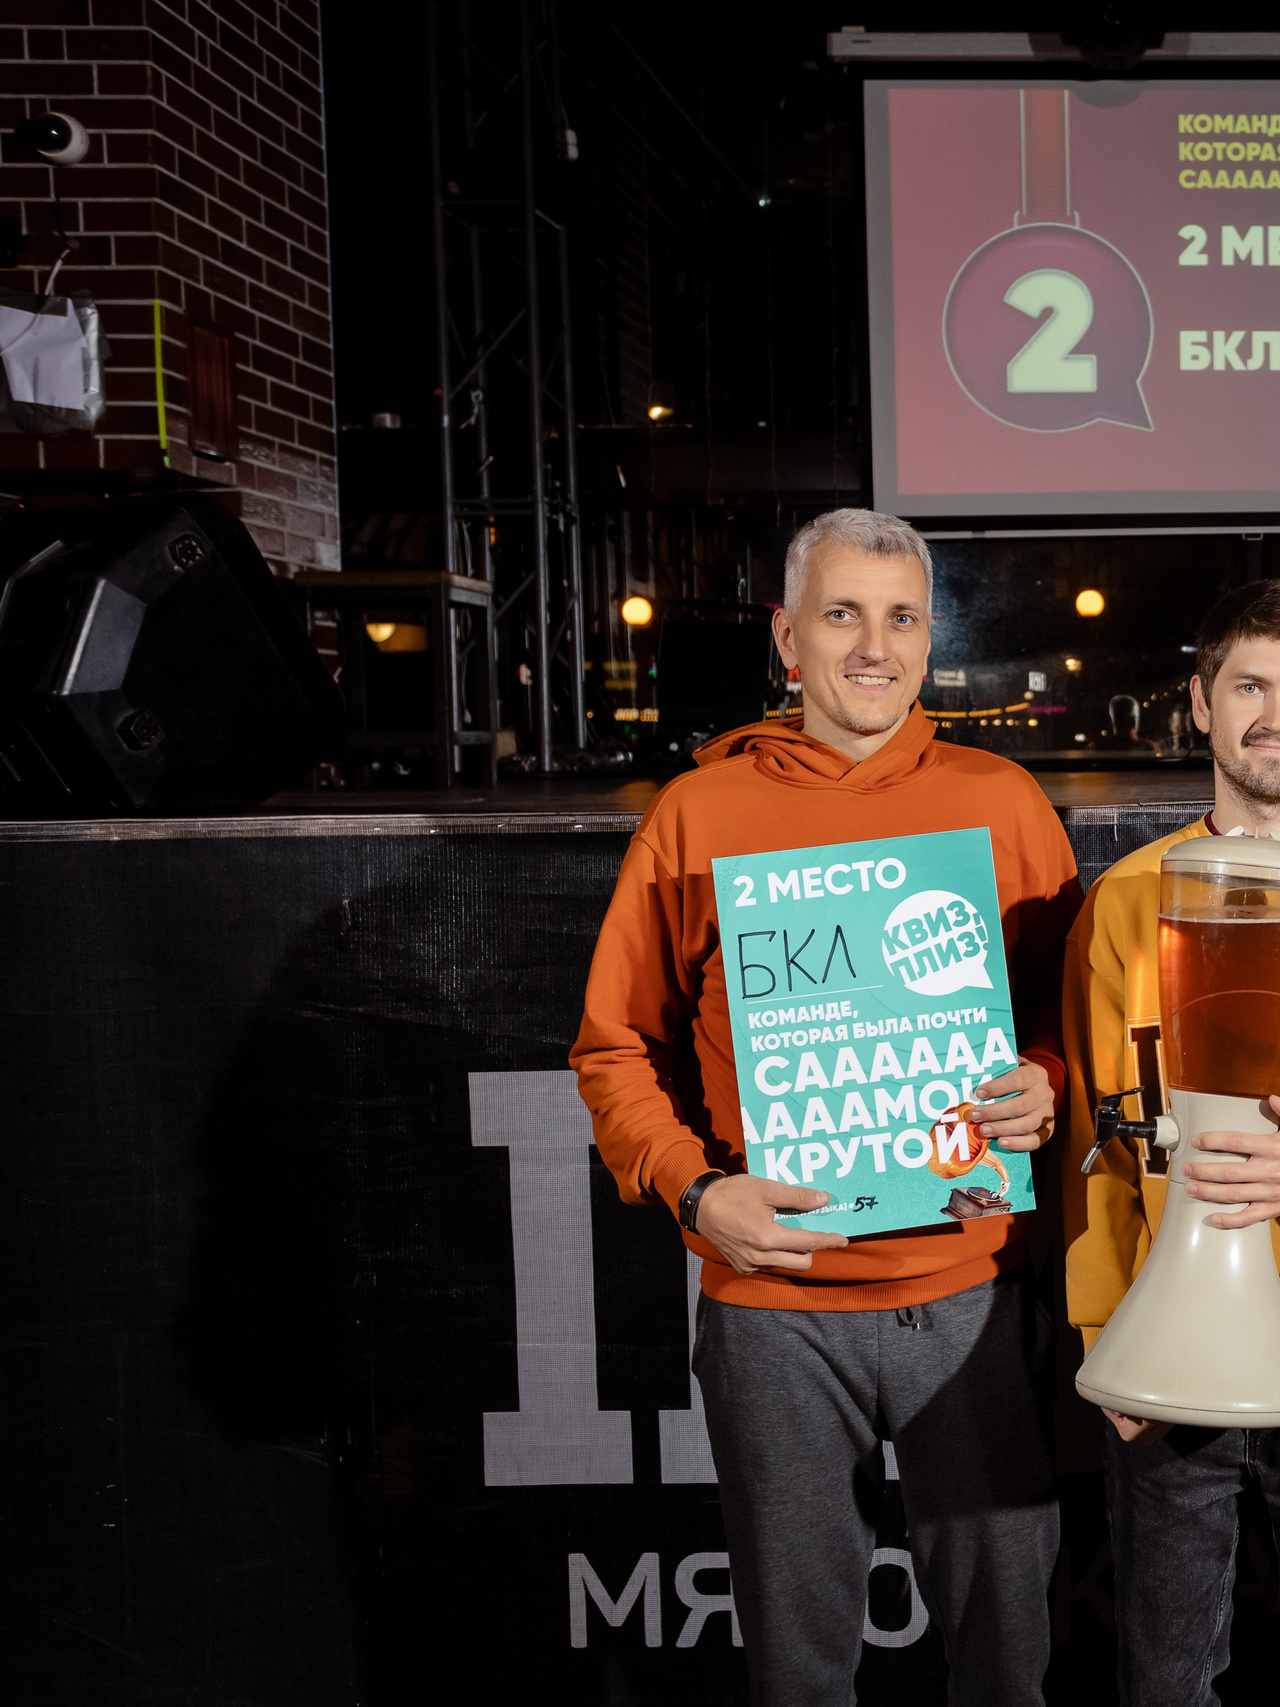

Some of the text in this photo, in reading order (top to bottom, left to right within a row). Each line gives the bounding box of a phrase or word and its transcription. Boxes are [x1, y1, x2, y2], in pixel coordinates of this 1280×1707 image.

[1178, 224, 1208, 266] 2
[1003, 268, 1097, 393] 2
[733, 857, 907, 908] 2 МЕСТО
[738, 925, 857, 999] БКЛ
[747, 1000, 859, 1029] КОМАНДЕ,
[750, 1006, 988, 1052] КОТОРАЯ БЫЛА ПОЧТИ
[754, 1027, 1017, 1096] САААААА
[764, 1113, 970, 1185] КРУТОЙ
[568, 1548, 929, 1648] МЯО
